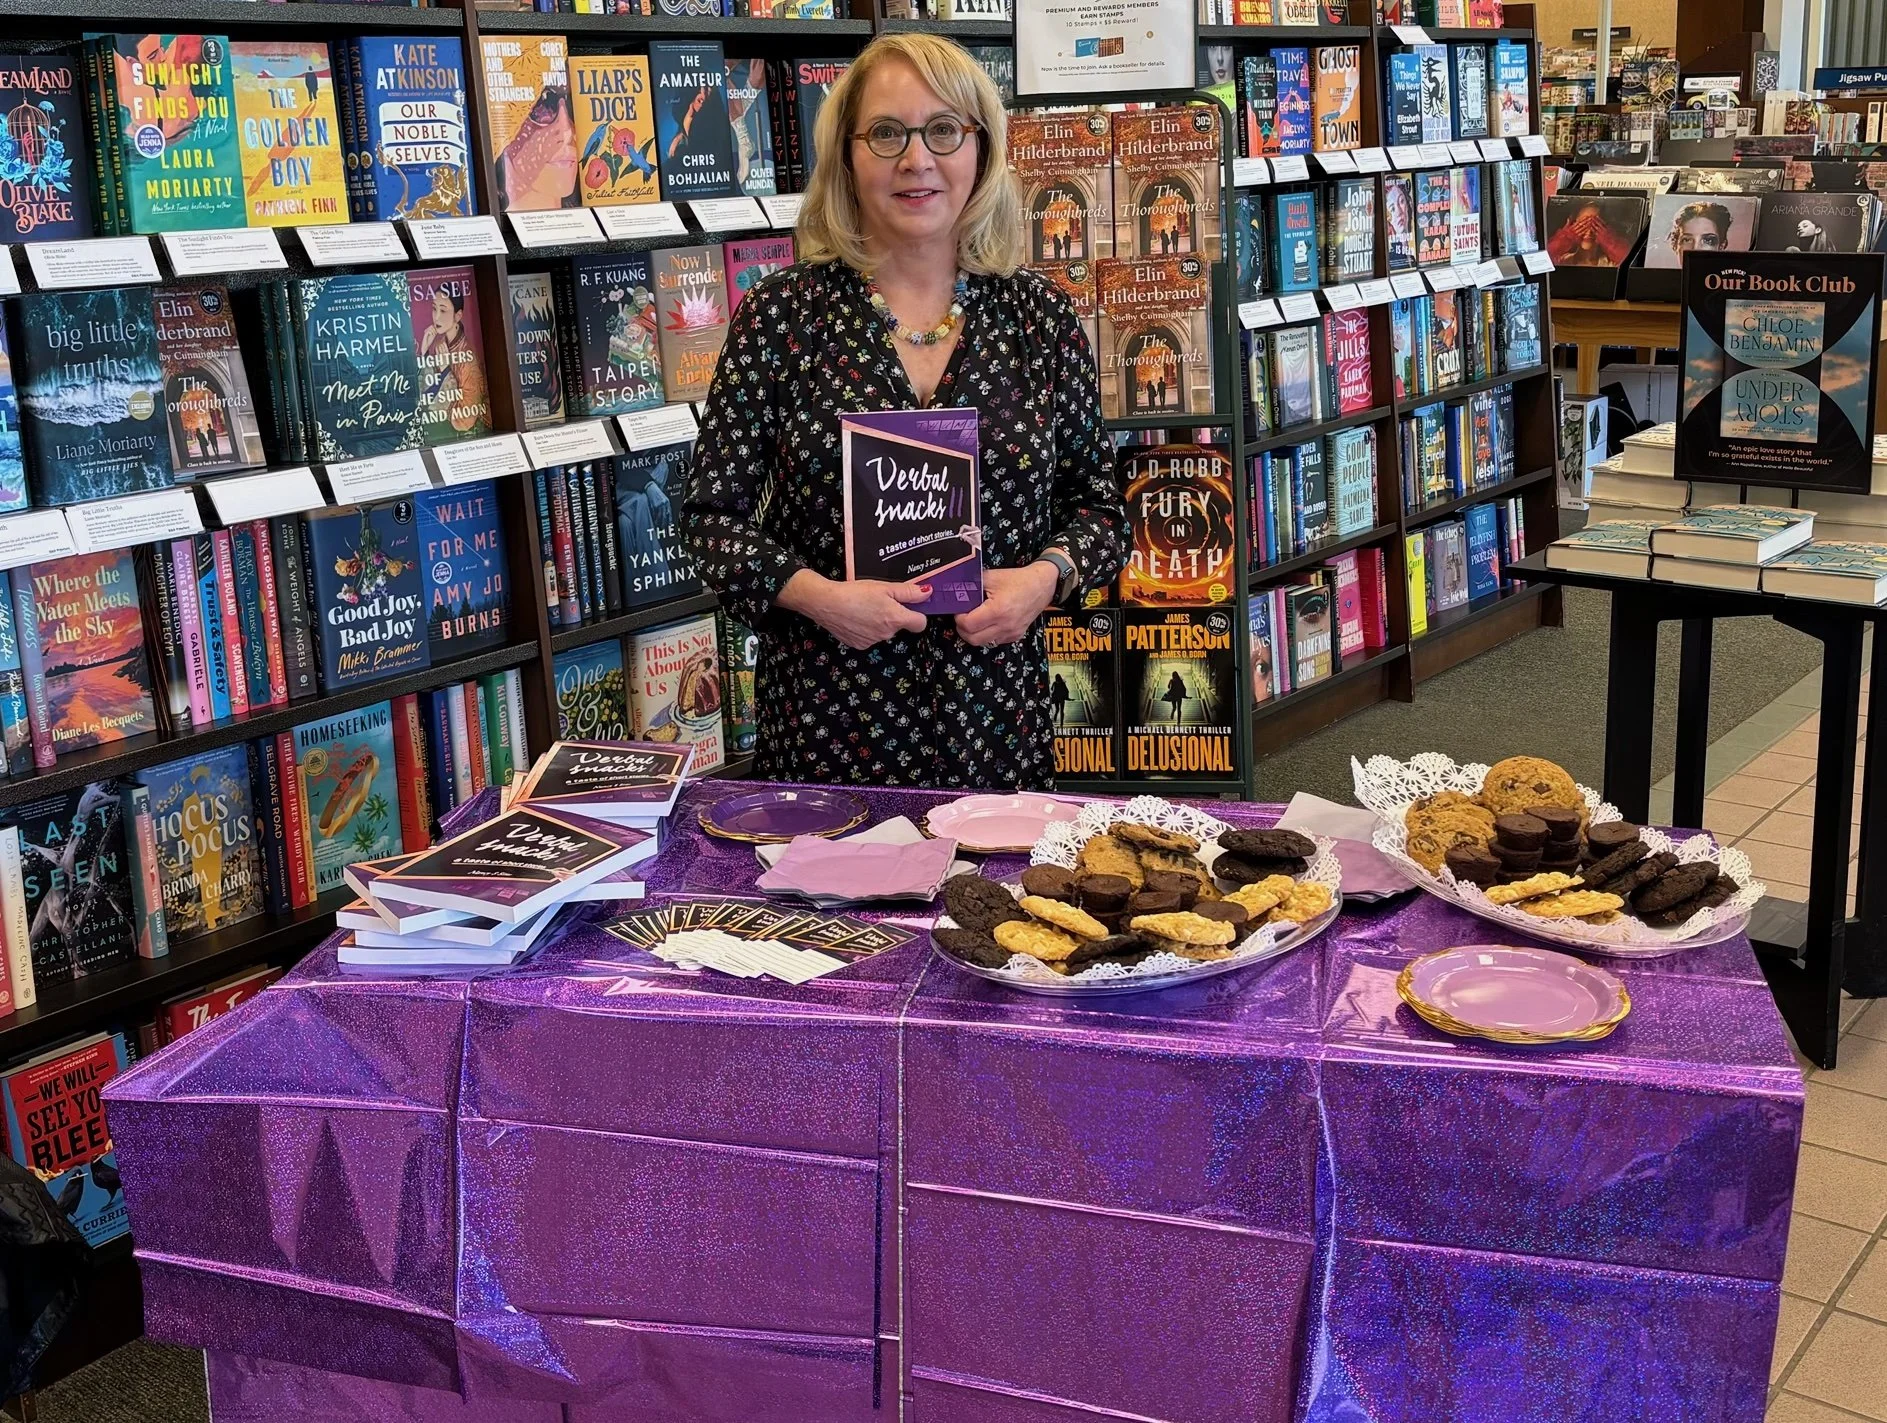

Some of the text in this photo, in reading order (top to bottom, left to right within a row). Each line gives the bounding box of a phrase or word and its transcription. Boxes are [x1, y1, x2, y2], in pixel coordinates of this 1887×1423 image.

[1093, 4, 1125, 12] REWARDS
[1126, 2, 1159, 10] MEMBERS
[394, 44, 438, 67] KATE
[484, 42, 521, 57] MOTHERS
[680, 55, 700, 67] THE
[1280, 52, 1304, 65] TIME
[1318, 47, 1359, 70] GHOST
[132, 64, 223, 87] SUNLIGHT
[377, 66, 460, 91] ATKINSON
[487, 72, 514, 87] OTHER
[577, 69, 644, 94] LIAR'S
[660, 73, 723, 88] AMATEUR
[1277, 70, 1309, 82] TRAVEL
[1838, 72, 1887, 85] Jigsaw Pu
[268, 88, 298, 110] THE
[489, 87, 536, 103] STRANGERS
[133, 96, 229, 120] FINDS YOU
[401, 103, 438, 119] OUR
[590, 97, 638, 122] DICE
[243, 117, 330, 149] GOLDEN
[395, 125, 449, 140] NOBLE
[1150, 119, 1181, 135] Elin
[1320, 120, 1358, 147] TOWN
[161, 149, 215, 170] LAURA
[396, 147, 451, 163] SELVES
[1118, 138, 1213, 157] Hilderbrand
[271, 157, 312, 188] BOY
[683, 154, 715, 167] CHRIS
[146, 176, 234, 200] MORIARTY
[669, 171, 730, 185] BOHJALIAN
[1154, 184, 1181, 199] The
[1345, 186, 1373, 209] John
[13, 202, 74, 233] BLAKE
[255, 198, 338, 216] PATRICIA FINN
[1121, 202, 1216, 219] Thoroughbreds
[1771, 204, 1858, 218] ARIANA GRANDE
[1453, 236, 1479, 252] SAINTS
[1344, 252, 1373, 275] STUART
[581, 275, 592, 287] R.
[594, 273, 603, 284] F.
[606, 267, 647, 284] KUANG
[1704, 273, 1856, 294] Our Book Club
[46, 318, 137, 353] big little
[316, 312, 402, 337] KRISTIN
[1743, 317, 1804, 334] CHLOE
[317, 335, 408, 361] HARMEL
[1337, 336, 1366, 361] JILLS
[1730, 335, 1816, 353] BENJAMIN
[64, 354, 131, 383] truths
[592, 359, 658, 385] TAIPEI
[1436, 348, 1461, 374] CRUX
[322, 370, 411, 403] Meet Me
[596, 382, 659, 408] STORY
[1735, 378, 1804, 402] UNDER
[337, 400, 413, 429] in Paris
[56, 434, 157, 461] Liane Moriarty
[1728, 444, 1742, 452] "An
[1743, 446, 1758, 455] epic
[1776, 448, 1795, 458] story
[1731, 452, 1760, 462] grateful
[1761, 454, 1782, 462] exists
[1806, 458, 1833, 466] world."
[622, 450, 686, 472] MARK FROST
[1148, 459, 1164, 479] D.
[1170, 457, 1222, 479] ROBB
[1342, 460, 1370, 485] PEOPLE
[865, 455, 950, 493] Verbal
[435, 498, 485, 523] WAIT
[874, 491, 947, 528] snacks
[1141, 491, 1211, 518] FURY
[878, 528, 955, 557] a taste of short stories.
[1171, 524, 1185, 538] IN
[428, 529, 497, 561] FOR ME
[1471, 548, 1497, 567] PROBLEM
[1128, 548, 1224, 580] DEATH
[34, 565, 121, 600] Where the
[433, 574, 502, 608] AMY JO
[633, 564, 698, 594] SPHINX
[85, 591, 132, 615] Meets
[327, 593, 422, 626] Good Joy,
[55, 616, 115, 645] the Sky
[441, 607, 501, 641] BURNS
[1164, 614, 1190, 624] JAMES
[204, 582, 226, 695] Trust & Safety
[339, 618, 417, 649] Bad Joy
[1126, 624, 1230, 651] PATTERSON
[337, 650, 369, 675] Mikki
[373, 640, 423, 667] Brammer
[642, 632, 713, 663] This Is Not
[231, 642, 247, 695] SCAVENGERS
[644, 658, 689, 680] About
[1298, 659, 1316, 683] SONG
[644, 680, 668, 698] Us
[52, 710, 145, 743] Diane Les Becquets
[301, 709, 388, 748] HOMESEEKING
[1133, 727, 1165, 735] MICHAEL
[1166, 727, 1196, 735] BENNETT
[1197, 727, 1232, 735] THRILLER
[1127, 735, 1234, 772] DELUSIONAL
[265, 744, 282, 840] BELGRAVE ROAD
[19, 805, 111, 854] LAST
[152, 794, 229, 848] HOCUS
[177, 814, 251, 866] POCUS
[24, 850, 118, 900] SEEN
[205, 865, 253, 900] CHARRY
[38, 1063, 97, 1101] WE WILL
[27, 1099, 72, 1140] SEE
